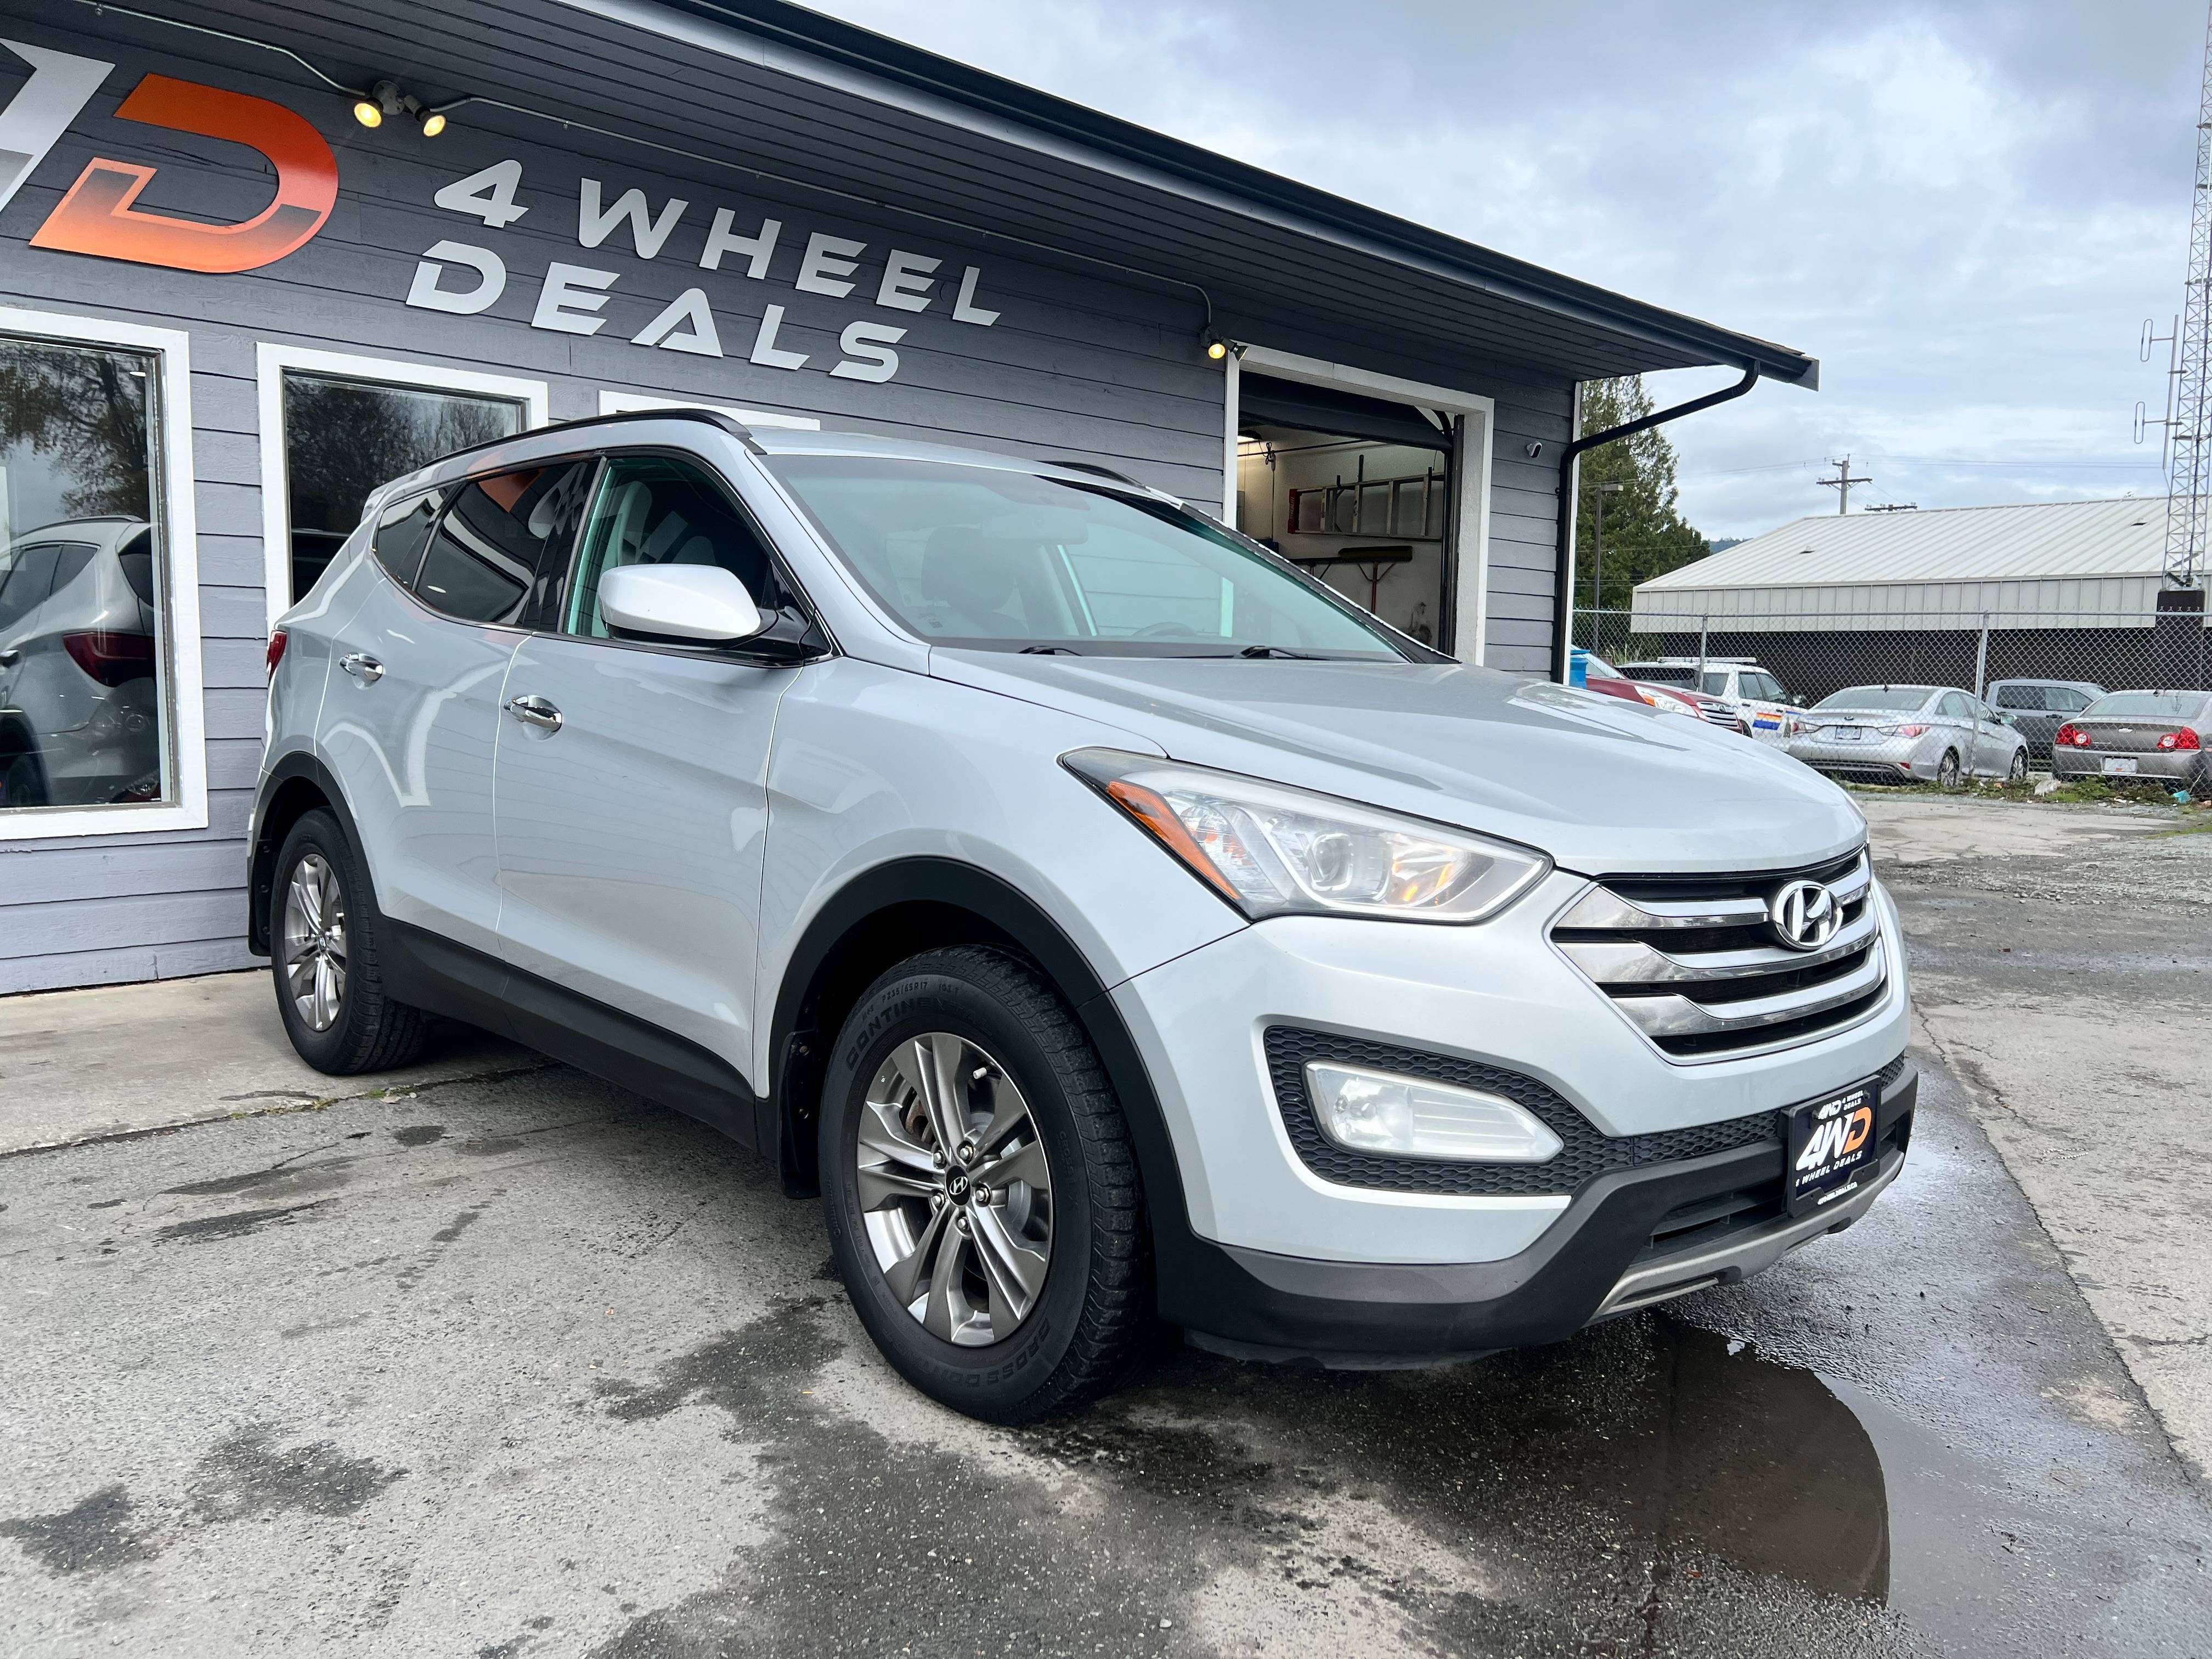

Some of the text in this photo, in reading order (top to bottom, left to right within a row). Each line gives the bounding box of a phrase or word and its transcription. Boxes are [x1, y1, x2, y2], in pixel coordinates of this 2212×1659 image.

[433, 160, 1001, 326] 4 WHEEL
[405, 240, 909, 383] DEALS
[1843, 1098, 1861, 1111] DEALS
[1802, 1165, 1831, 1185] WHEEL
[1833, 1150, 1863, 1170] DEALS
